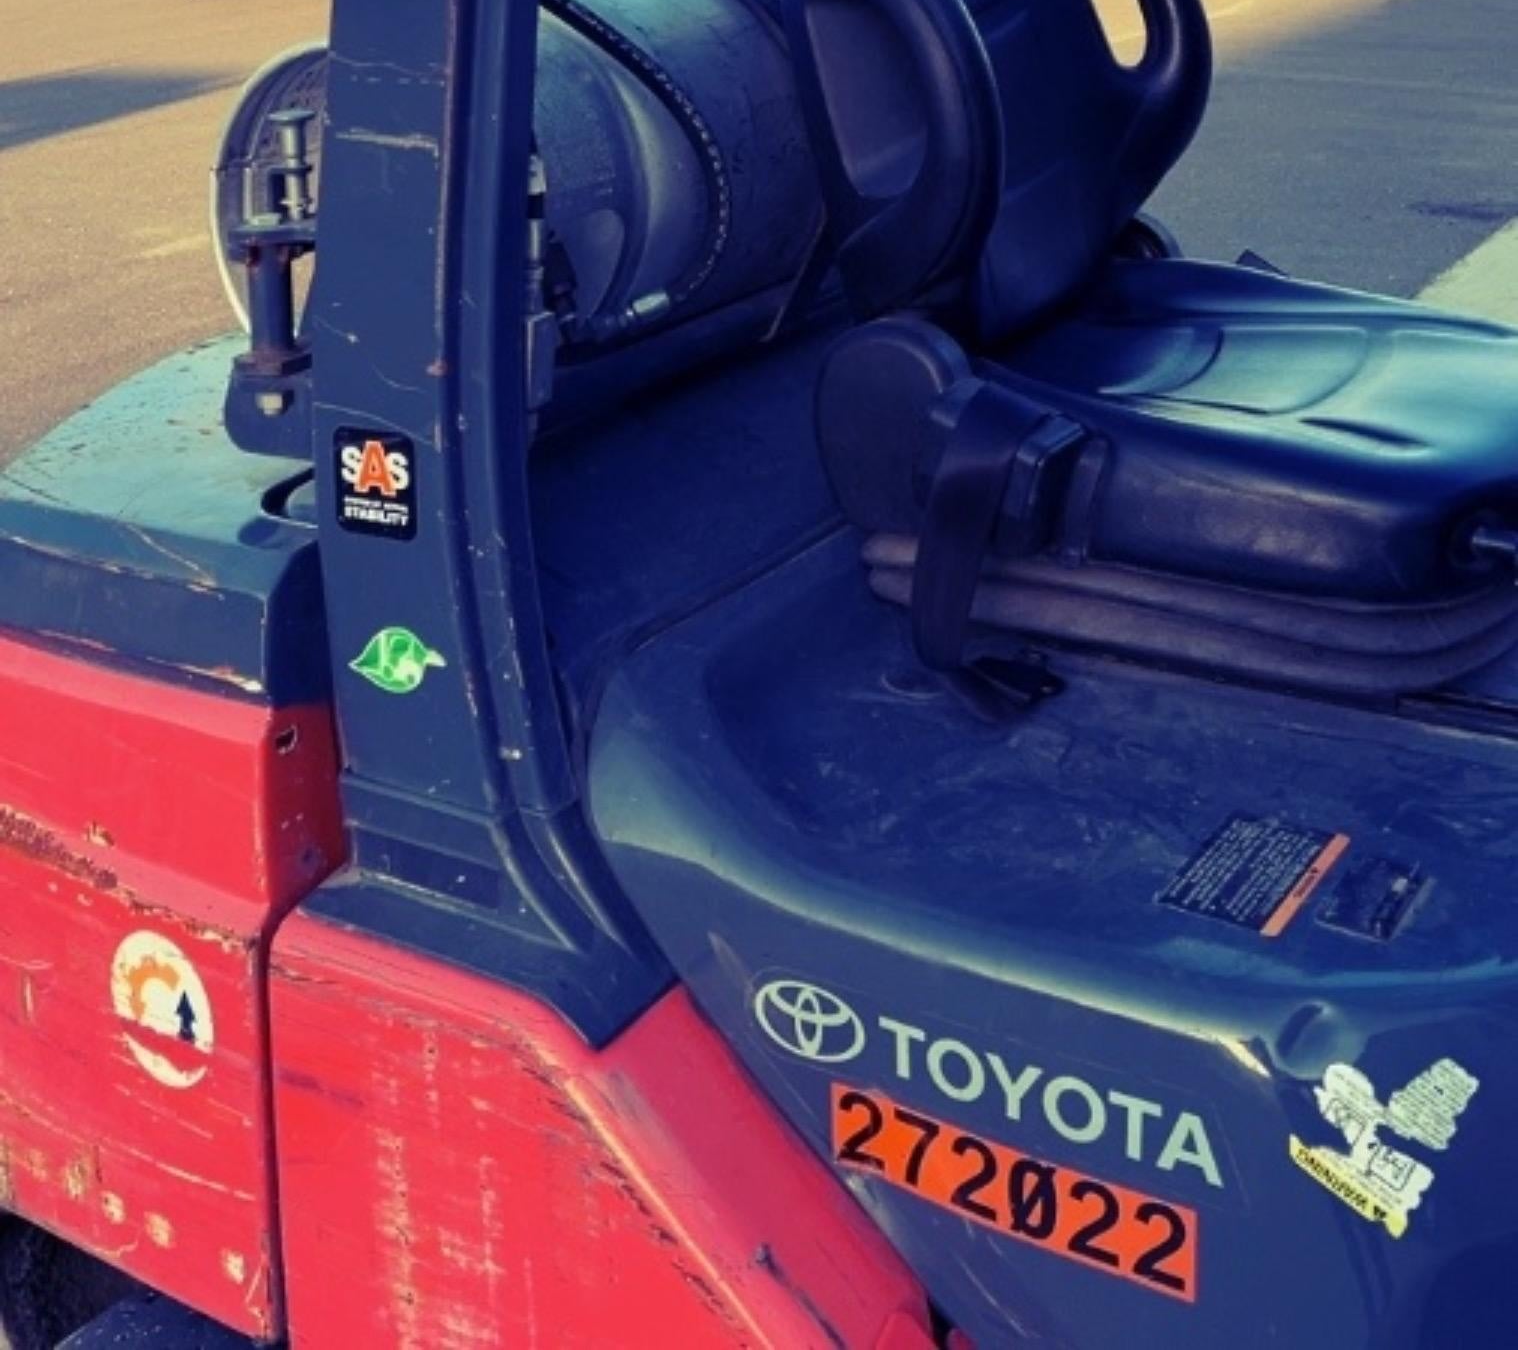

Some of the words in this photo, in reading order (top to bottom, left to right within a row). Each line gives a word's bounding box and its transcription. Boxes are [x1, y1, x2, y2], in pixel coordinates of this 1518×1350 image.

[341, 441, 409, 496] SAS
[879, 1016, 1225, 1188] TOYOTA
[838, 1091, 1187, 1292] 272022
